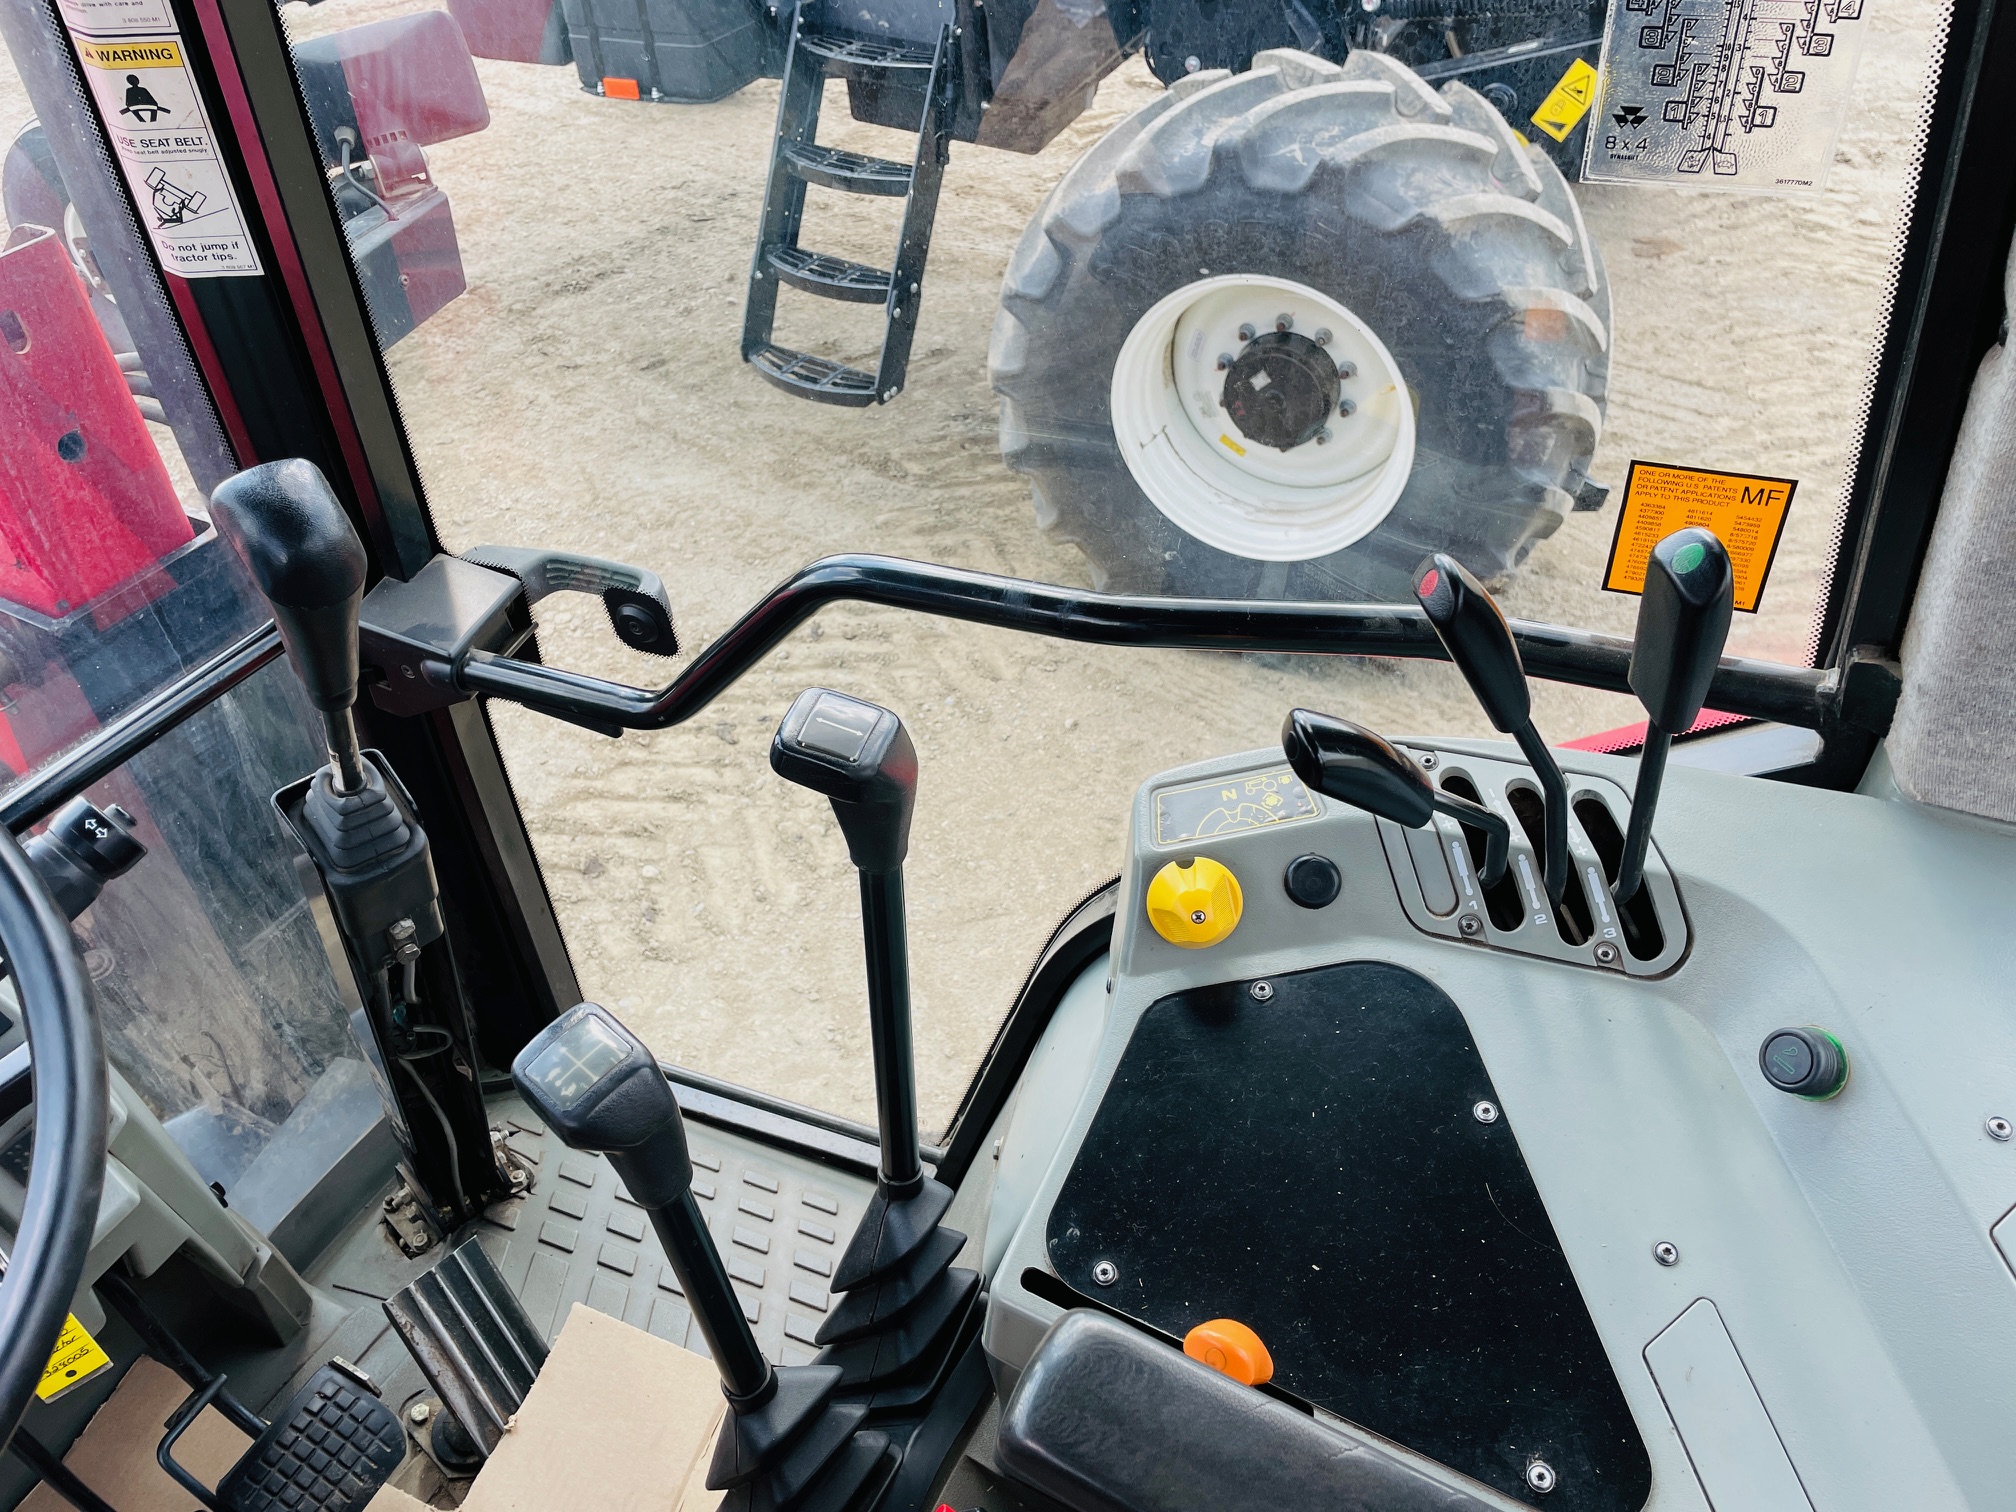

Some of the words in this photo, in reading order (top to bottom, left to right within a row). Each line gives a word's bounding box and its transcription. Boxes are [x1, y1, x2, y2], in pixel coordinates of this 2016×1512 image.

[1841, 0, 1855, 16] 4
[1645, 30, 1659, 45] 3
[1813, 37, 1828, 53] 3
[95, 47, 174, 62] WARNING
[1657, 68, 1670, 83] 2
[1782, 74, 1799, 91] 2
[1671, 105, 1679, 118] 1
[1758, 110, 1768, 124] 1
[117, 134, 137, 148] USE
[140, 138, 171, 148] SEAT
[173, 136, 208, 147] BELT.
[1605, 135, 1617, 150] 8
[1621, 140, 1630, 151] x
[1635, 138, 1648, 152] 4
[161, 240, 175, 251] Do
[178, 243, 197, 252] not
[200, 243, 228, 252] jump
[231, 241, 239, 250] if
[171, 253, 208, 262] tractor
[211, 253, 237, 261] tips.
[1638, 476, 1684, 488] FOLLOWING
[1703, 484, 1738, 494] PATENTS
[1640, 469, 1656, 477] ONE
[1672, 473, 1695, 482] MORE
[1711, 478, 1726, 486] THE
[1635, 490, 1658, 498] APPLY
[1673, 494, 1690, 502] THIS
[1692, 497, 1730, 507] PRODUCT
[1650, 485, 1679, 494] PATENT
[1681, 488, 1737, 501] APPLICATIONS
[1740, 486, 1785, 507] MF
[1221, 788, 1238, 801] N
[1468, 900, 1478, 910] 1
[1533, 914, 1548, 925] 2
[1603, 927, 1617, 939] 3
